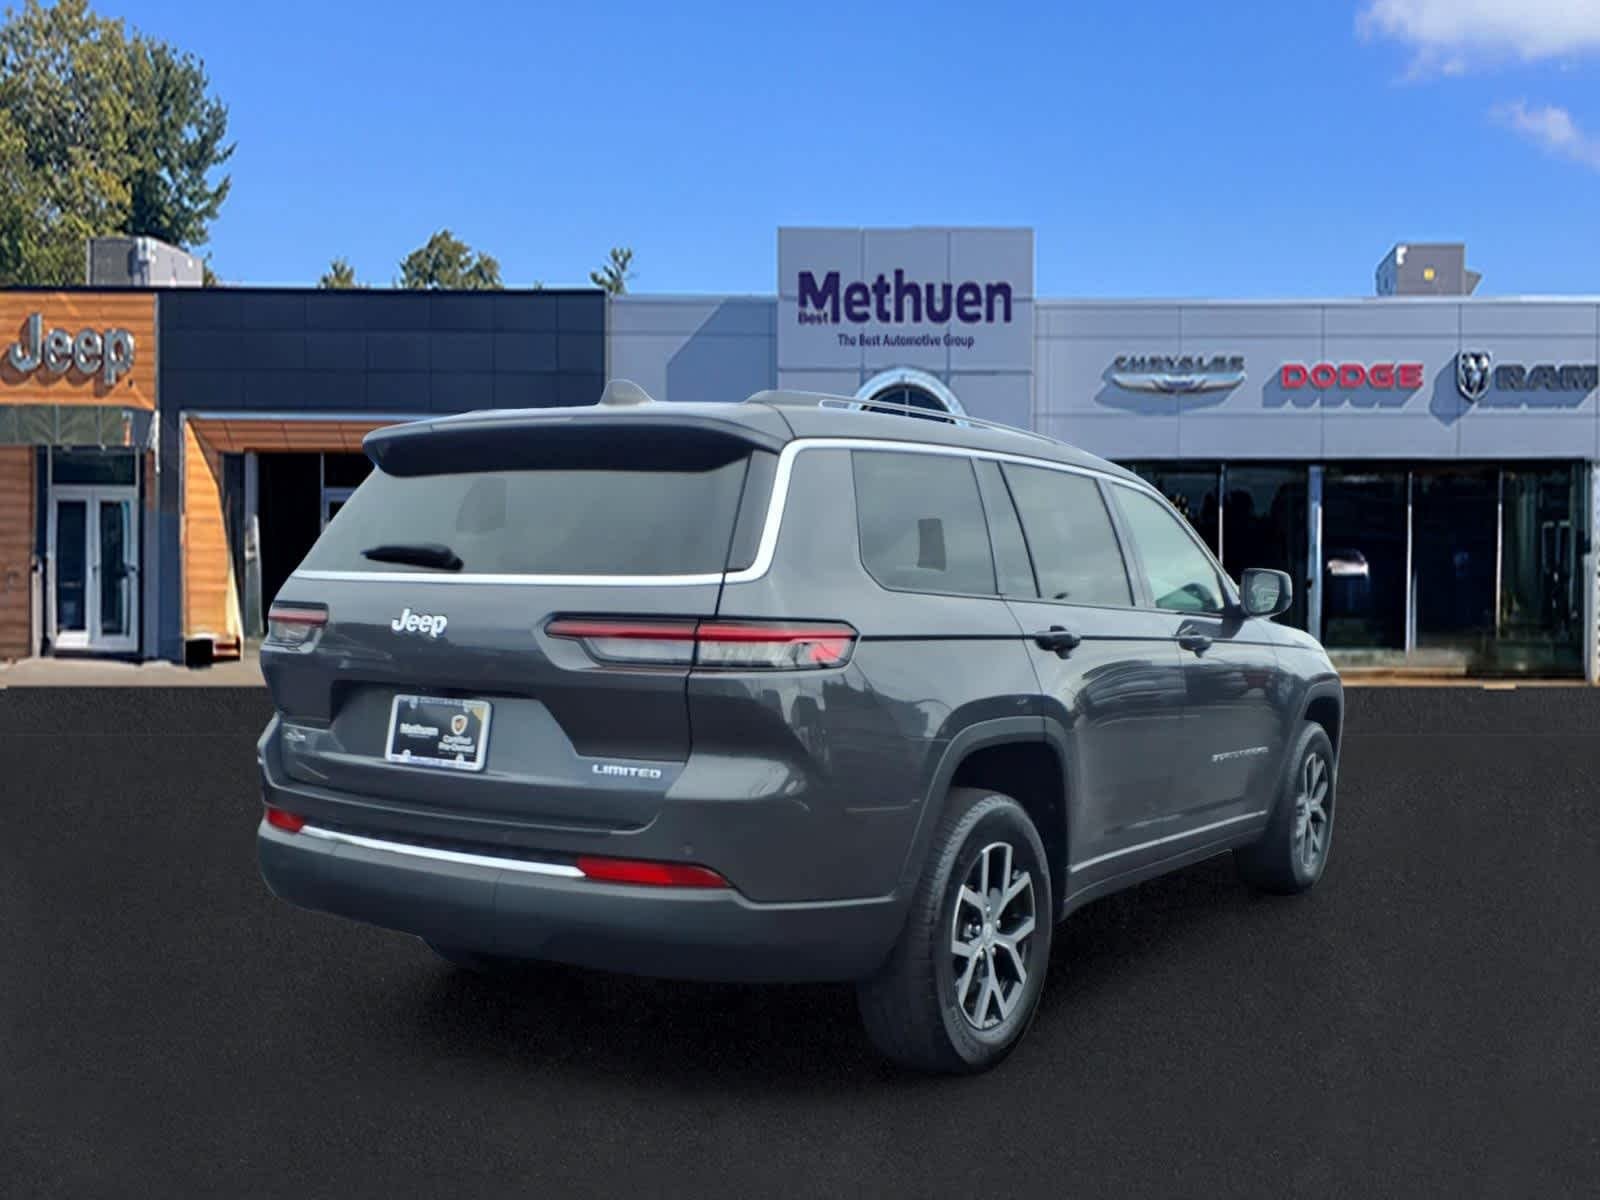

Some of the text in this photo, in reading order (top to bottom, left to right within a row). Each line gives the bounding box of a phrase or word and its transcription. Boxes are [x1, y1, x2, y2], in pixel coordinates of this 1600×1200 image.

[798, 268, 1013, 324] Methuen
[9, 312, 134, 385] Jeep
[838, 334, 975, 349] The Best Automotive Group
[1281, 364, 1424, 389] DODGE
[1495, 365, 1598, 391] RAM
[391, 608, 448, 638] Jeep
[591, 764, 662, 779] LIMITED
